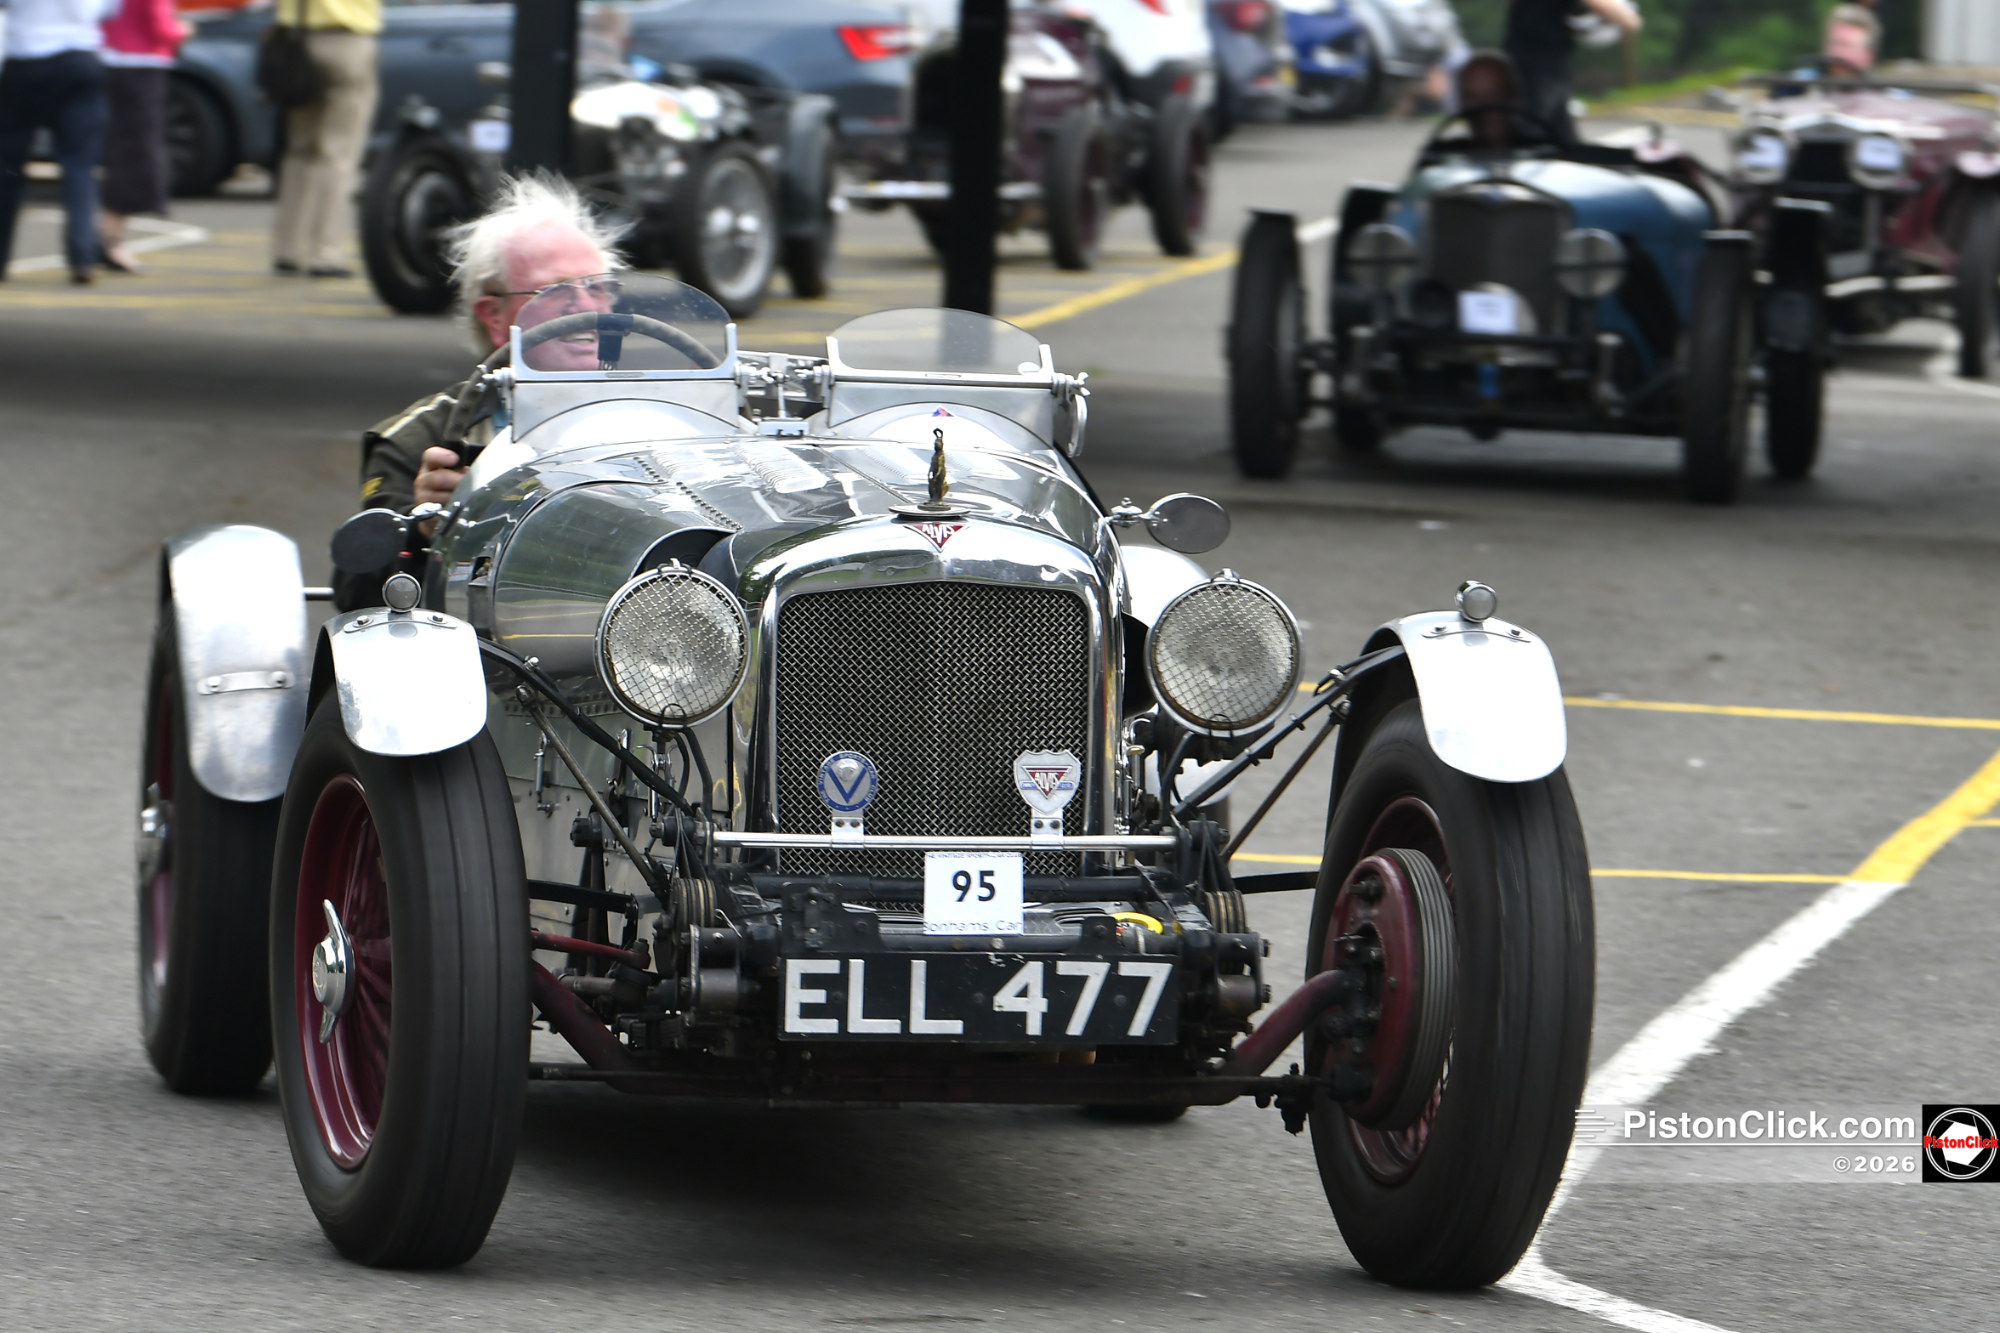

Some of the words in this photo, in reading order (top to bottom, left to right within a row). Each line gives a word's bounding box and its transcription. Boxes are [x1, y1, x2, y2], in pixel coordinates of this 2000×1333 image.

[952, 870, 996, 902] 95
[784, 958, 964, 1036] ELL
[992, 961, 1173, 1038] 477
